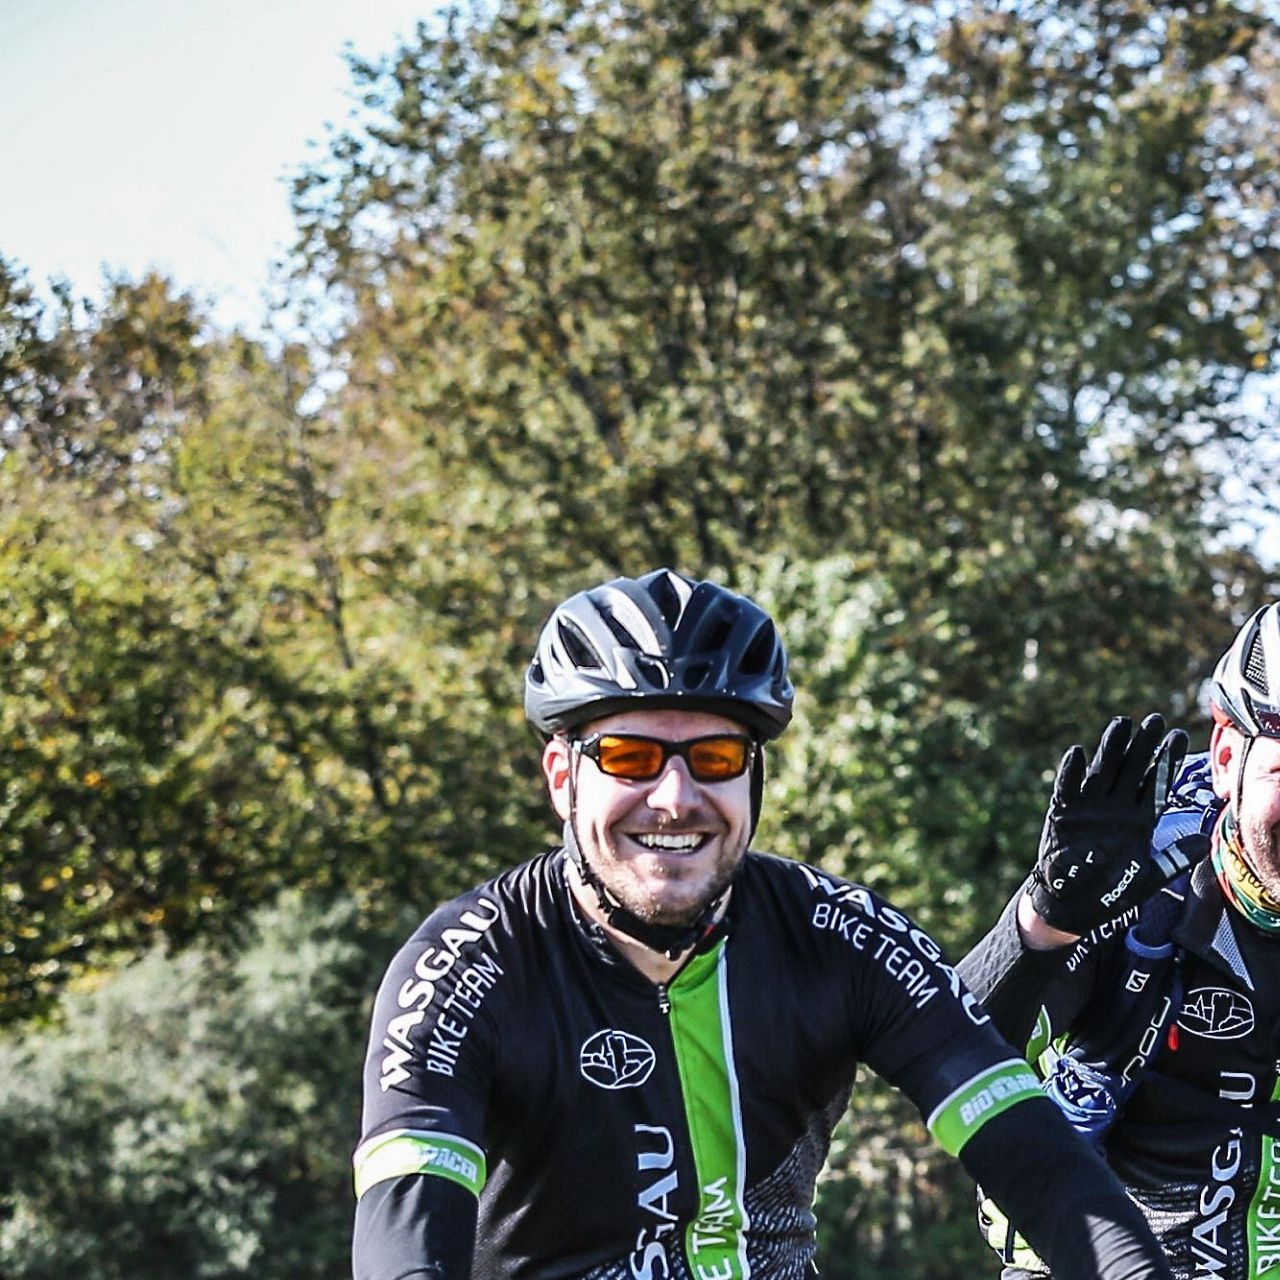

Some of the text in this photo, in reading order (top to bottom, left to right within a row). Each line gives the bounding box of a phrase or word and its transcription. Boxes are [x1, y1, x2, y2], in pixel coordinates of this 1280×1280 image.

[1100, 860, 1140, 907] Roeckl
[379, 898, 500, 1093] WASGAU
[426, 951, 505, 1077] BIKE TEAM
[812, 903, 940, 1009] BIKE TEAM
